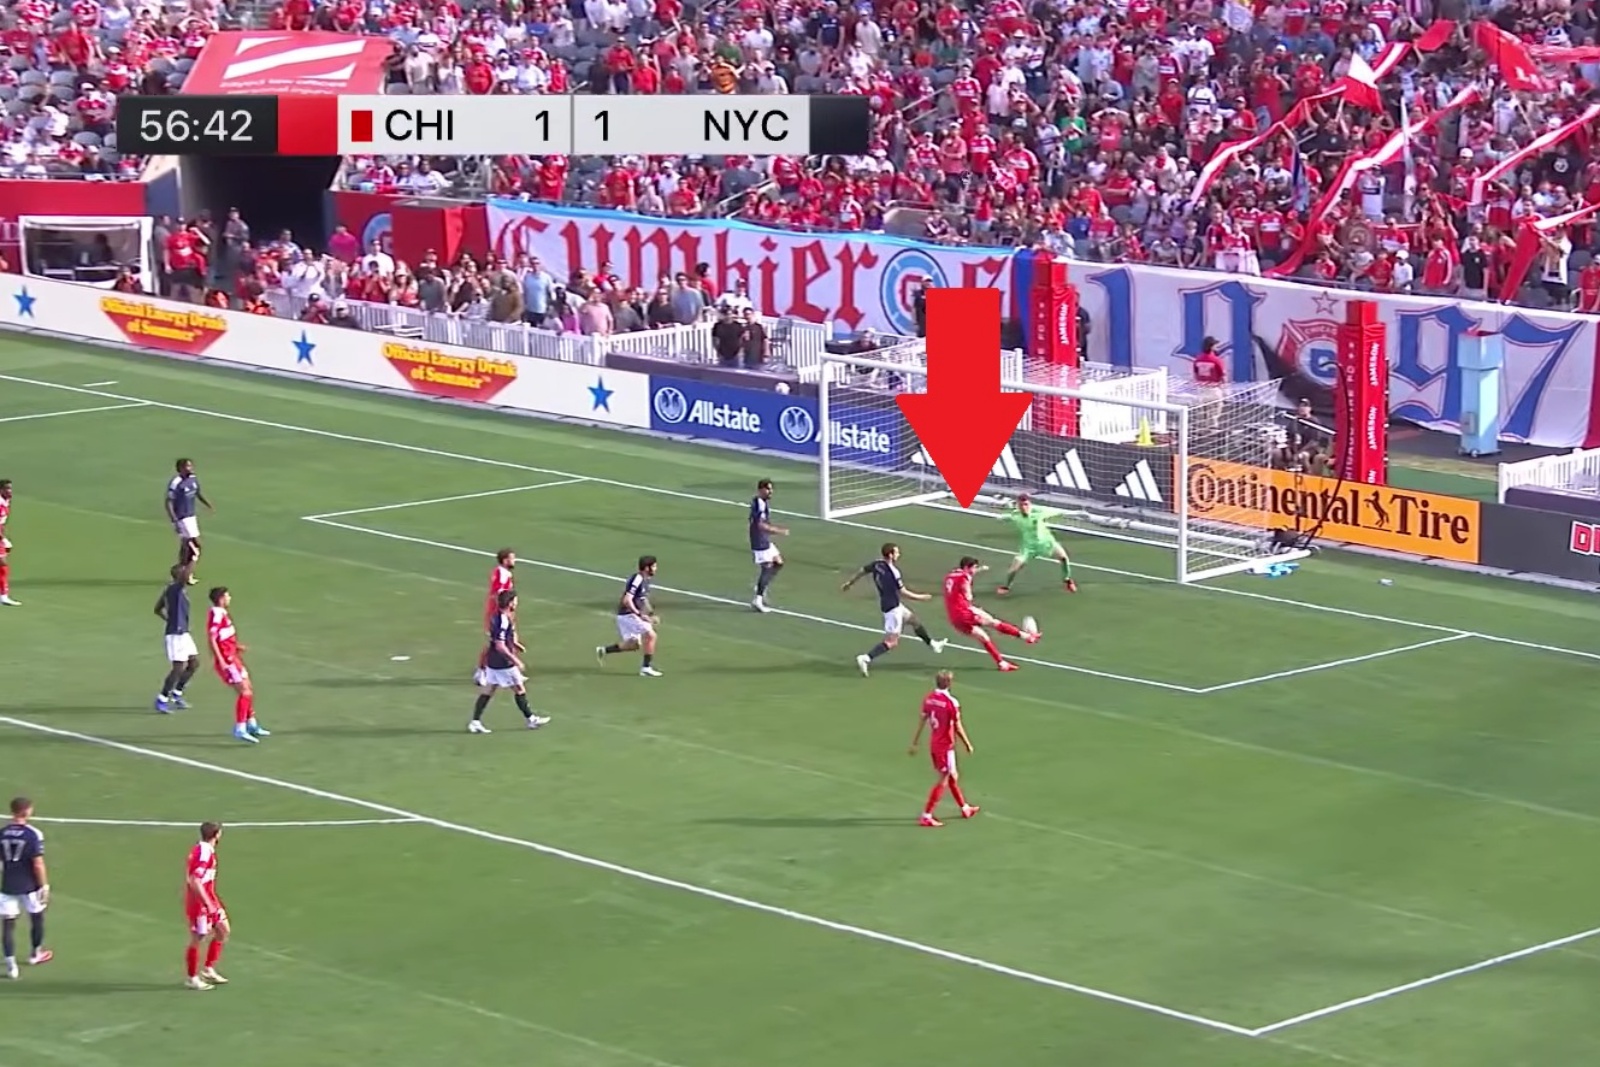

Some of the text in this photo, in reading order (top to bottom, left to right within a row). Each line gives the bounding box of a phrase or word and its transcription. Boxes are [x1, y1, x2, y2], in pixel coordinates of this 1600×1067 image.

[100, 296, 146, 316] Official
[1057, 302, 1070, 346] JAMESON
[383, 342, 517, 378] Official Energy Drink
[410, 365, 425, 380] of
[1369, 342, 1380, 387] JAMESON
[687, 399, 761, 433] Allstate
[1367, 406, 1378, 450] JAMESON
[1187, 463, 1470, 544] Continental Tire
[1, 839, 27, 861] 17
